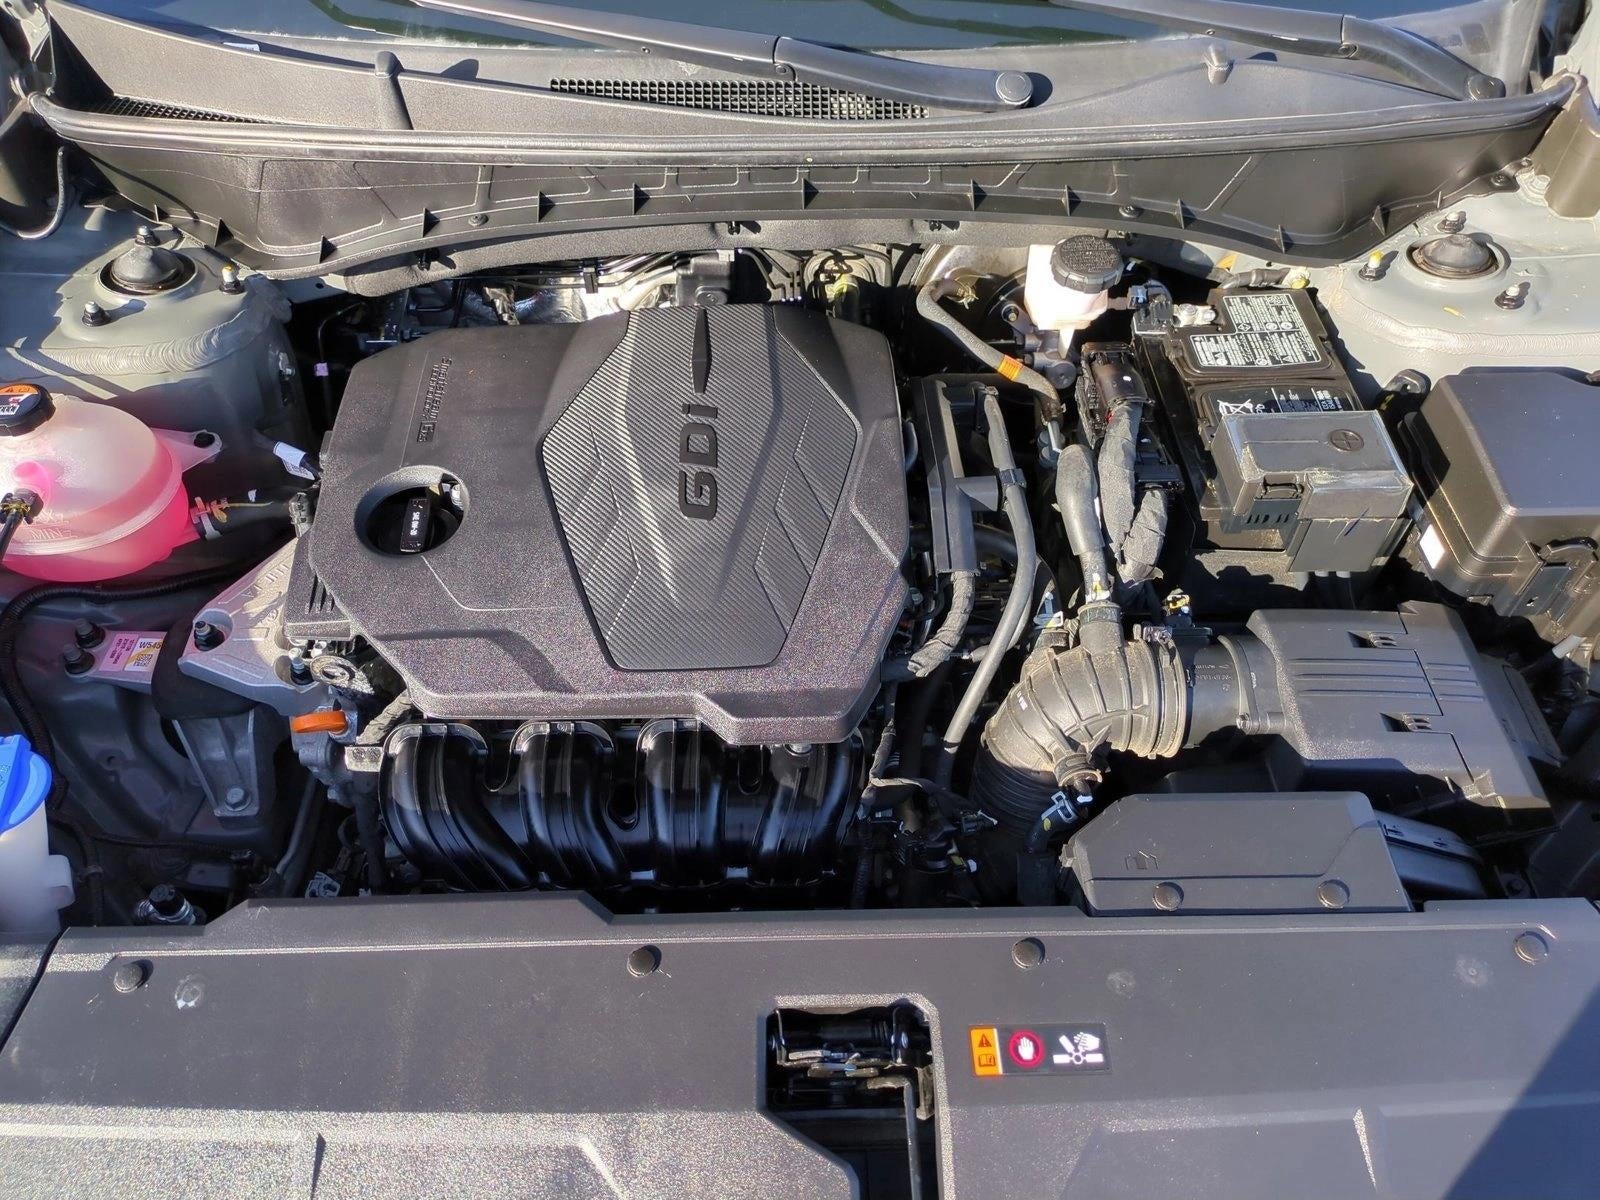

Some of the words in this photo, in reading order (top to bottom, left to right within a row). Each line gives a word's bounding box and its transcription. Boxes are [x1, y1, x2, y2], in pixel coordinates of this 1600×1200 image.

[422, 364, 439, 419] TECHNOLOGY
[430, 357, 452, 419] Smartstream
[31, 528, 63, 540] MIN
